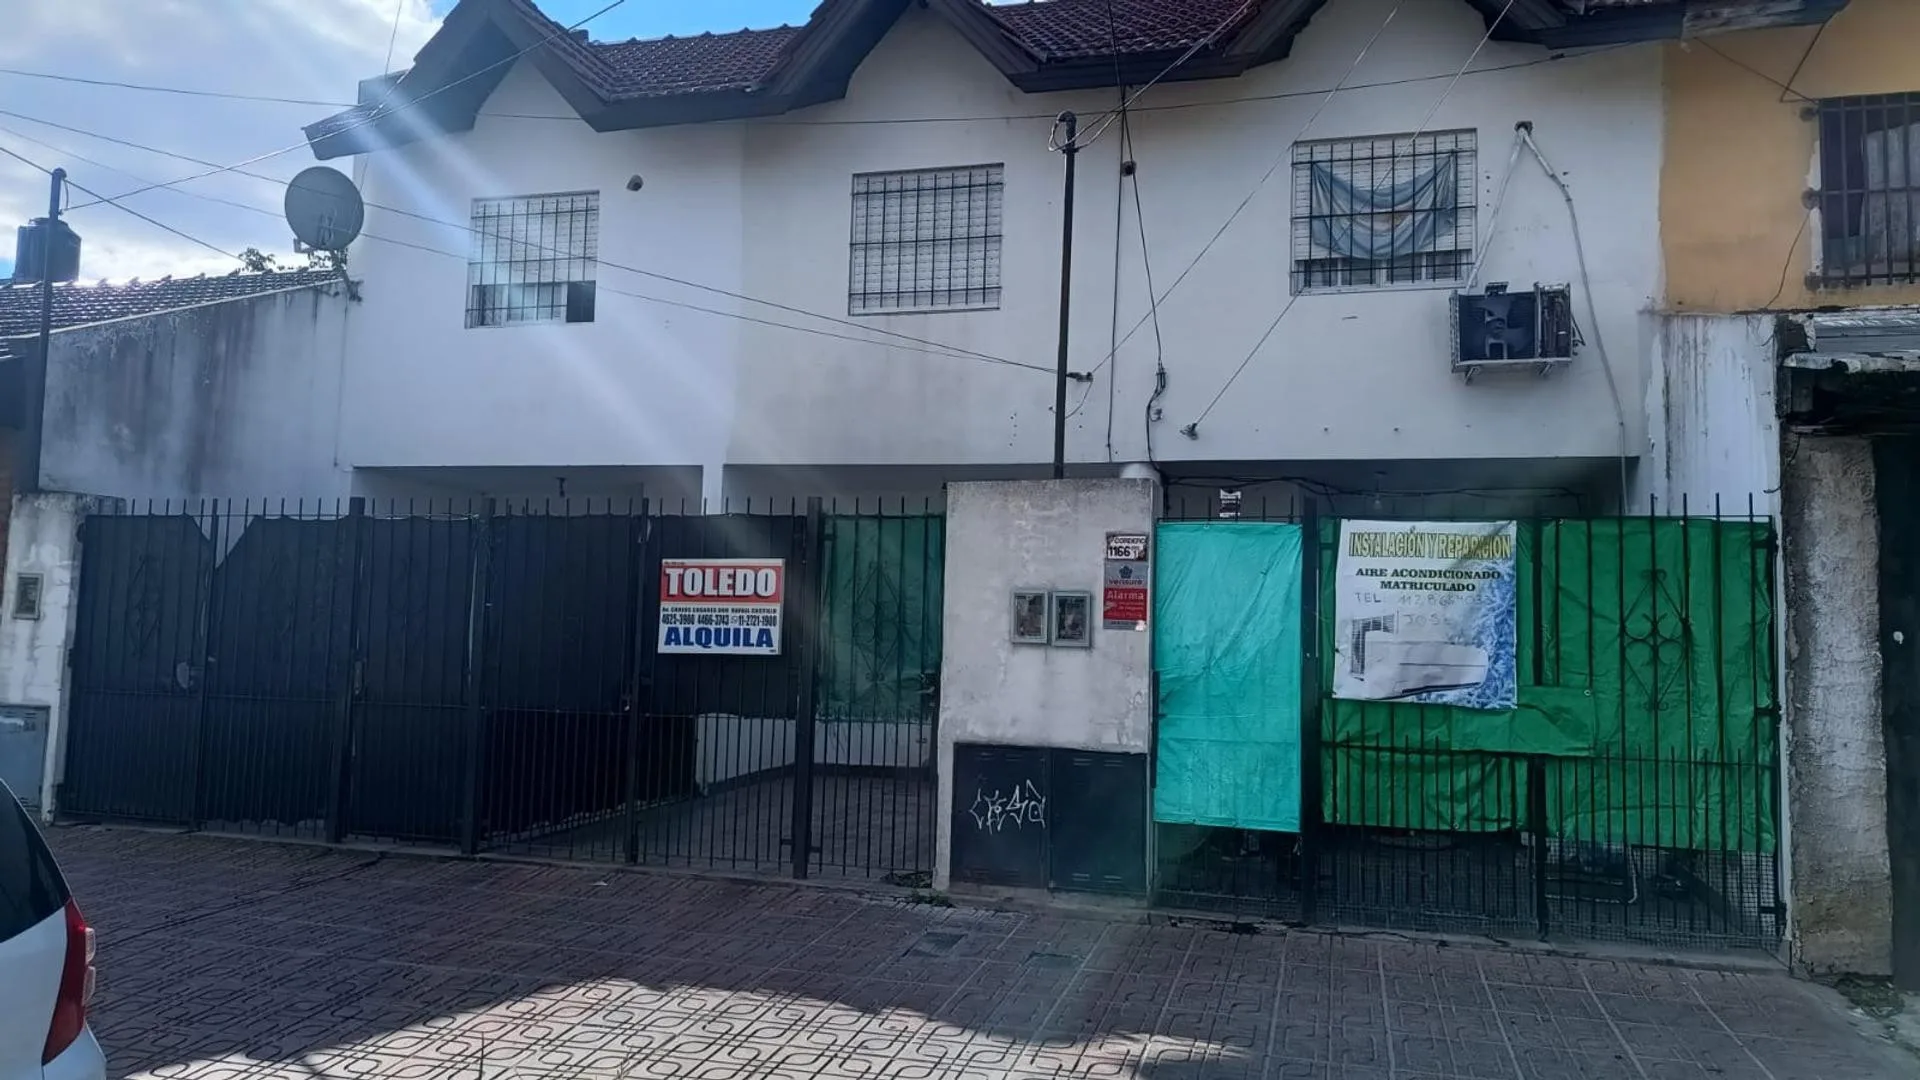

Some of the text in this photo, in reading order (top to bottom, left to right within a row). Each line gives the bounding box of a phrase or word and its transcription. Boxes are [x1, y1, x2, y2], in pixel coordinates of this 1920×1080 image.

[1109, 546, 1130, 557] 1166
[1426, 533, 1438, 558] Y
[1356, 568, 1500, 579] AIRE ACONDICIONADO
[665, 568, 776, 597] TOLEDO
[1380, 580, 1475, 592] MATRICULADO
[1107, 590, 1144, 600] Alarma
[664, 627, 773, 649] ALQUILA
